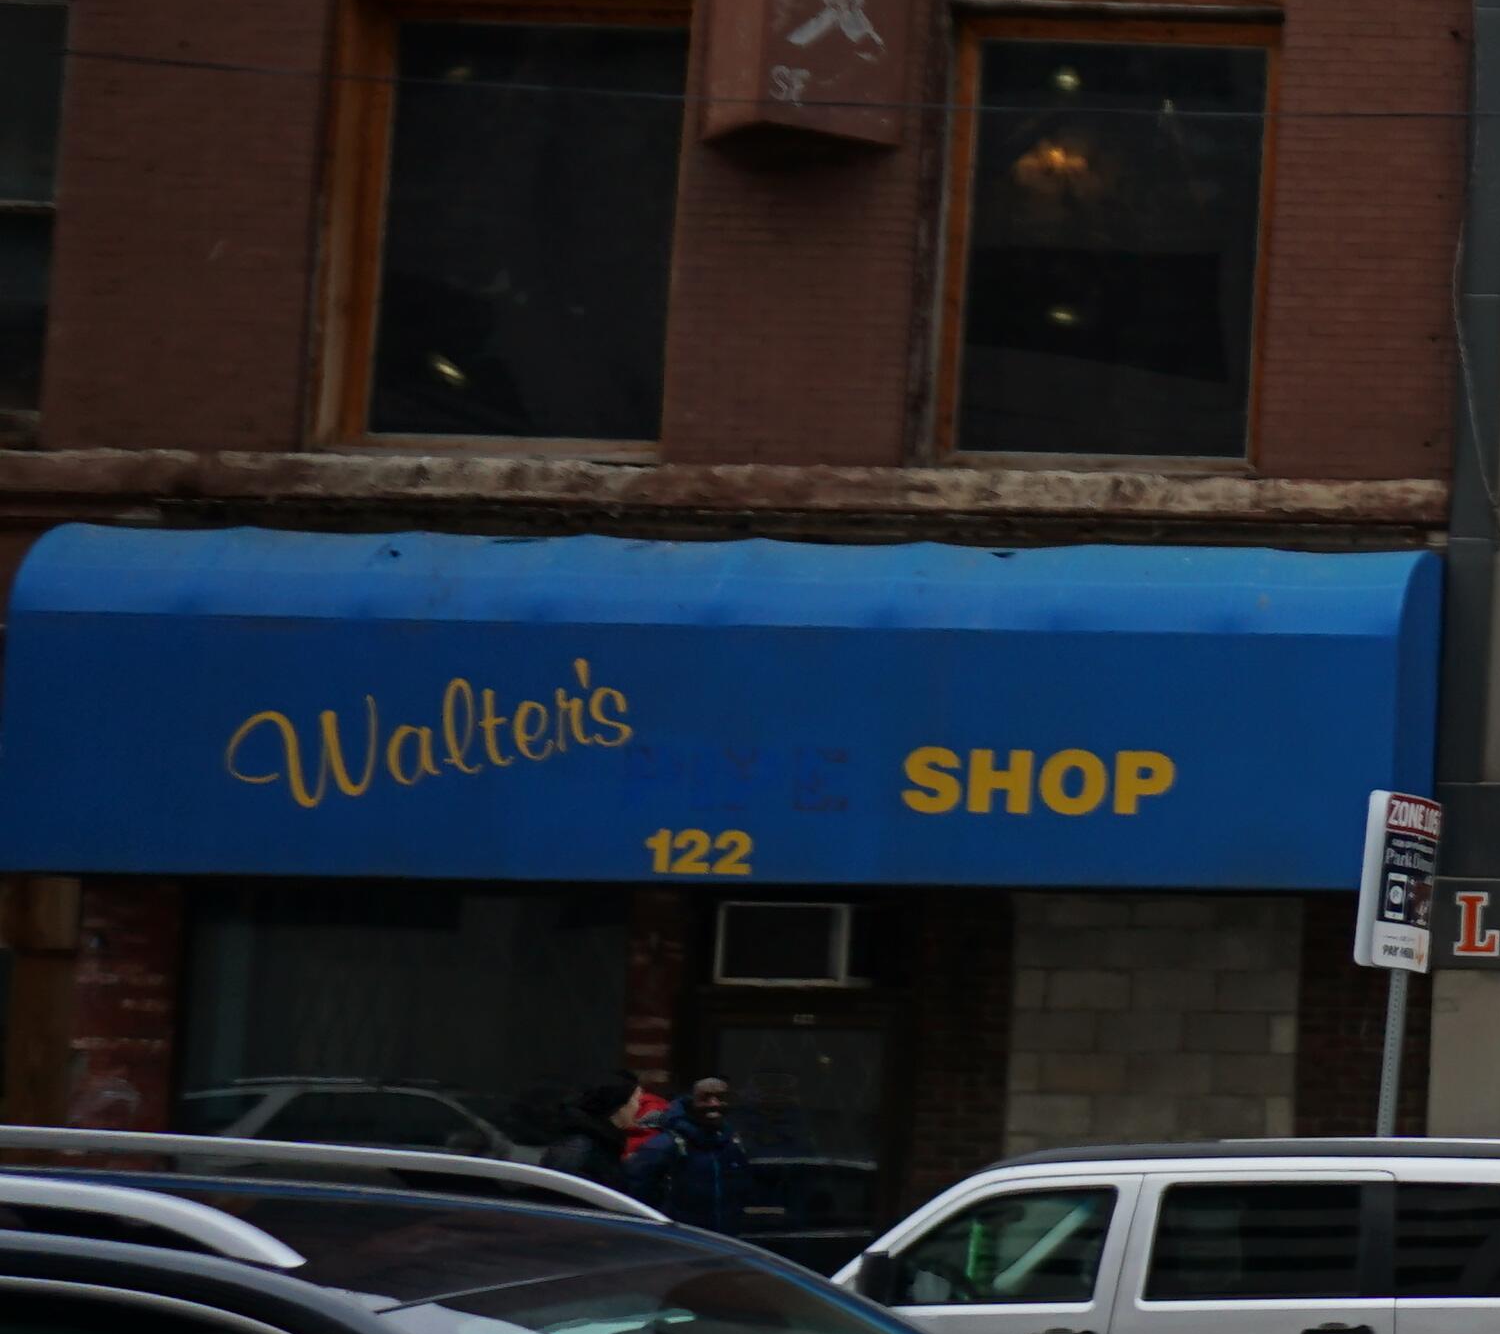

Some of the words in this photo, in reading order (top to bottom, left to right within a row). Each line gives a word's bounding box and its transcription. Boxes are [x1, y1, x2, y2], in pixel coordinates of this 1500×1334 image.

[225, 660, 633, 808] Walter's
[902, 746, 1176, 817] SHOP
[1387, 798, 1425, 831] ZONE
[645, 827, 753, 875] 122
